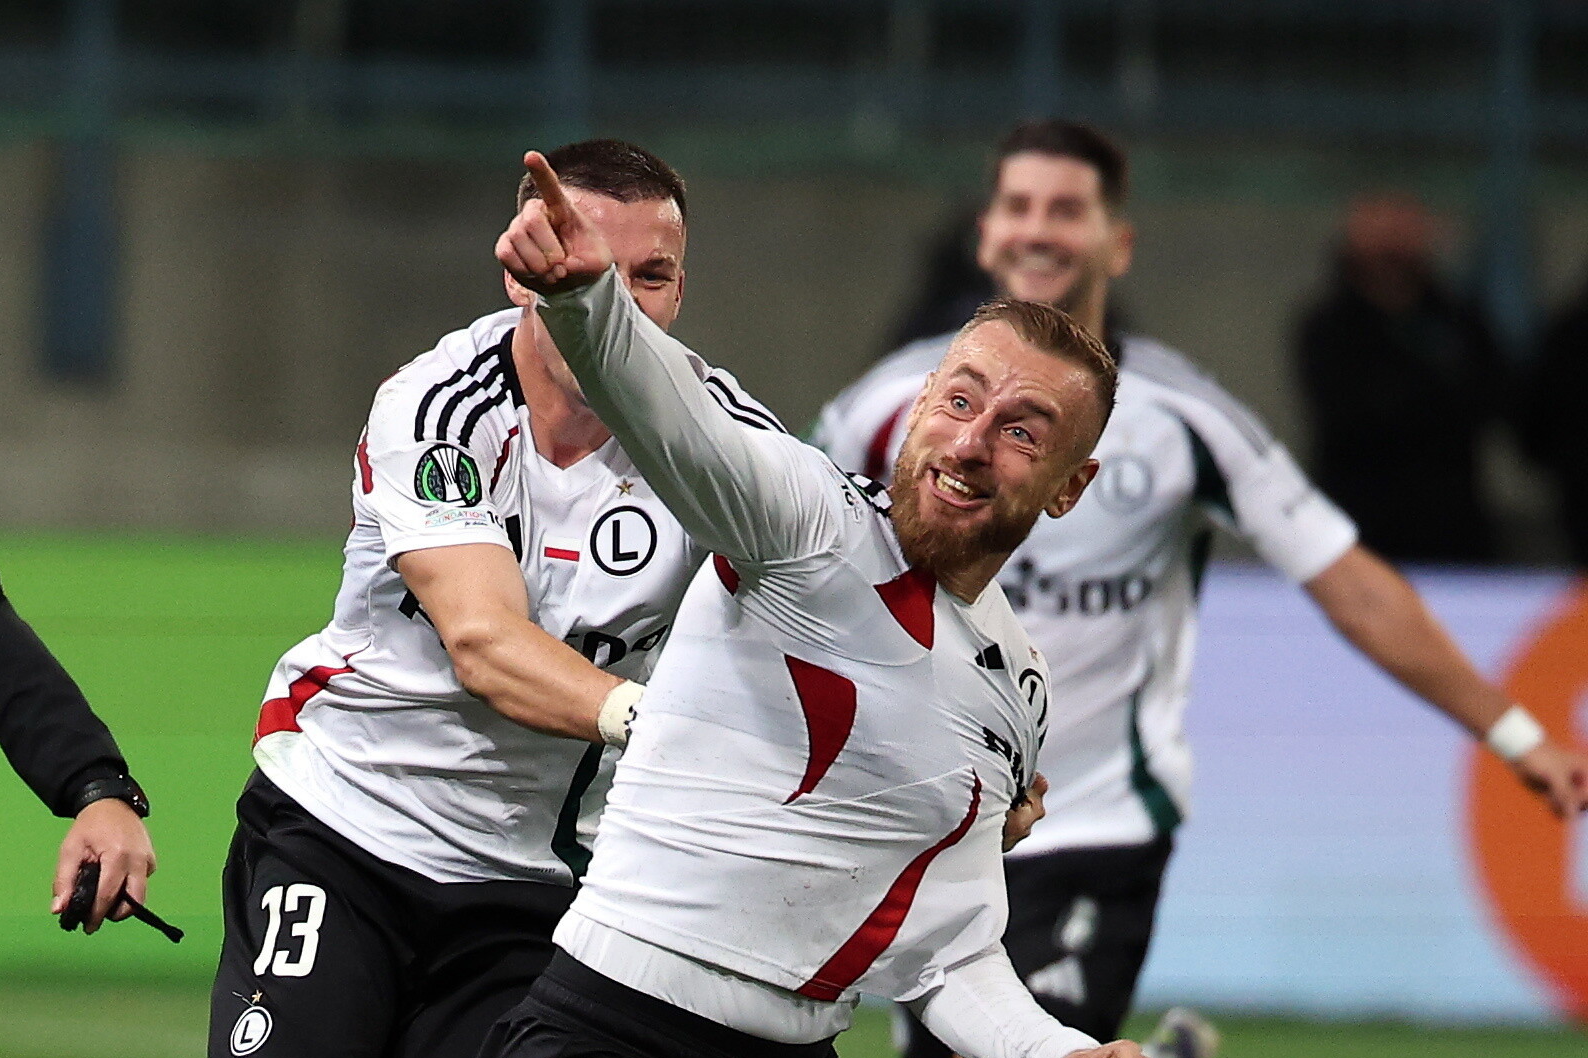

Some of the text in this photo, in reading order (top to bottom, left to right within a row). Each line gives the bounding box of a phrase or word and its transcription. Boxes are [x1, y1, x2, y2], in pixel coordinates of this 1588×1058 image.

[613, 519, 638, 562] L
[253, 883, 327, 977] 13
[239, 1019, 253, 1044] L
